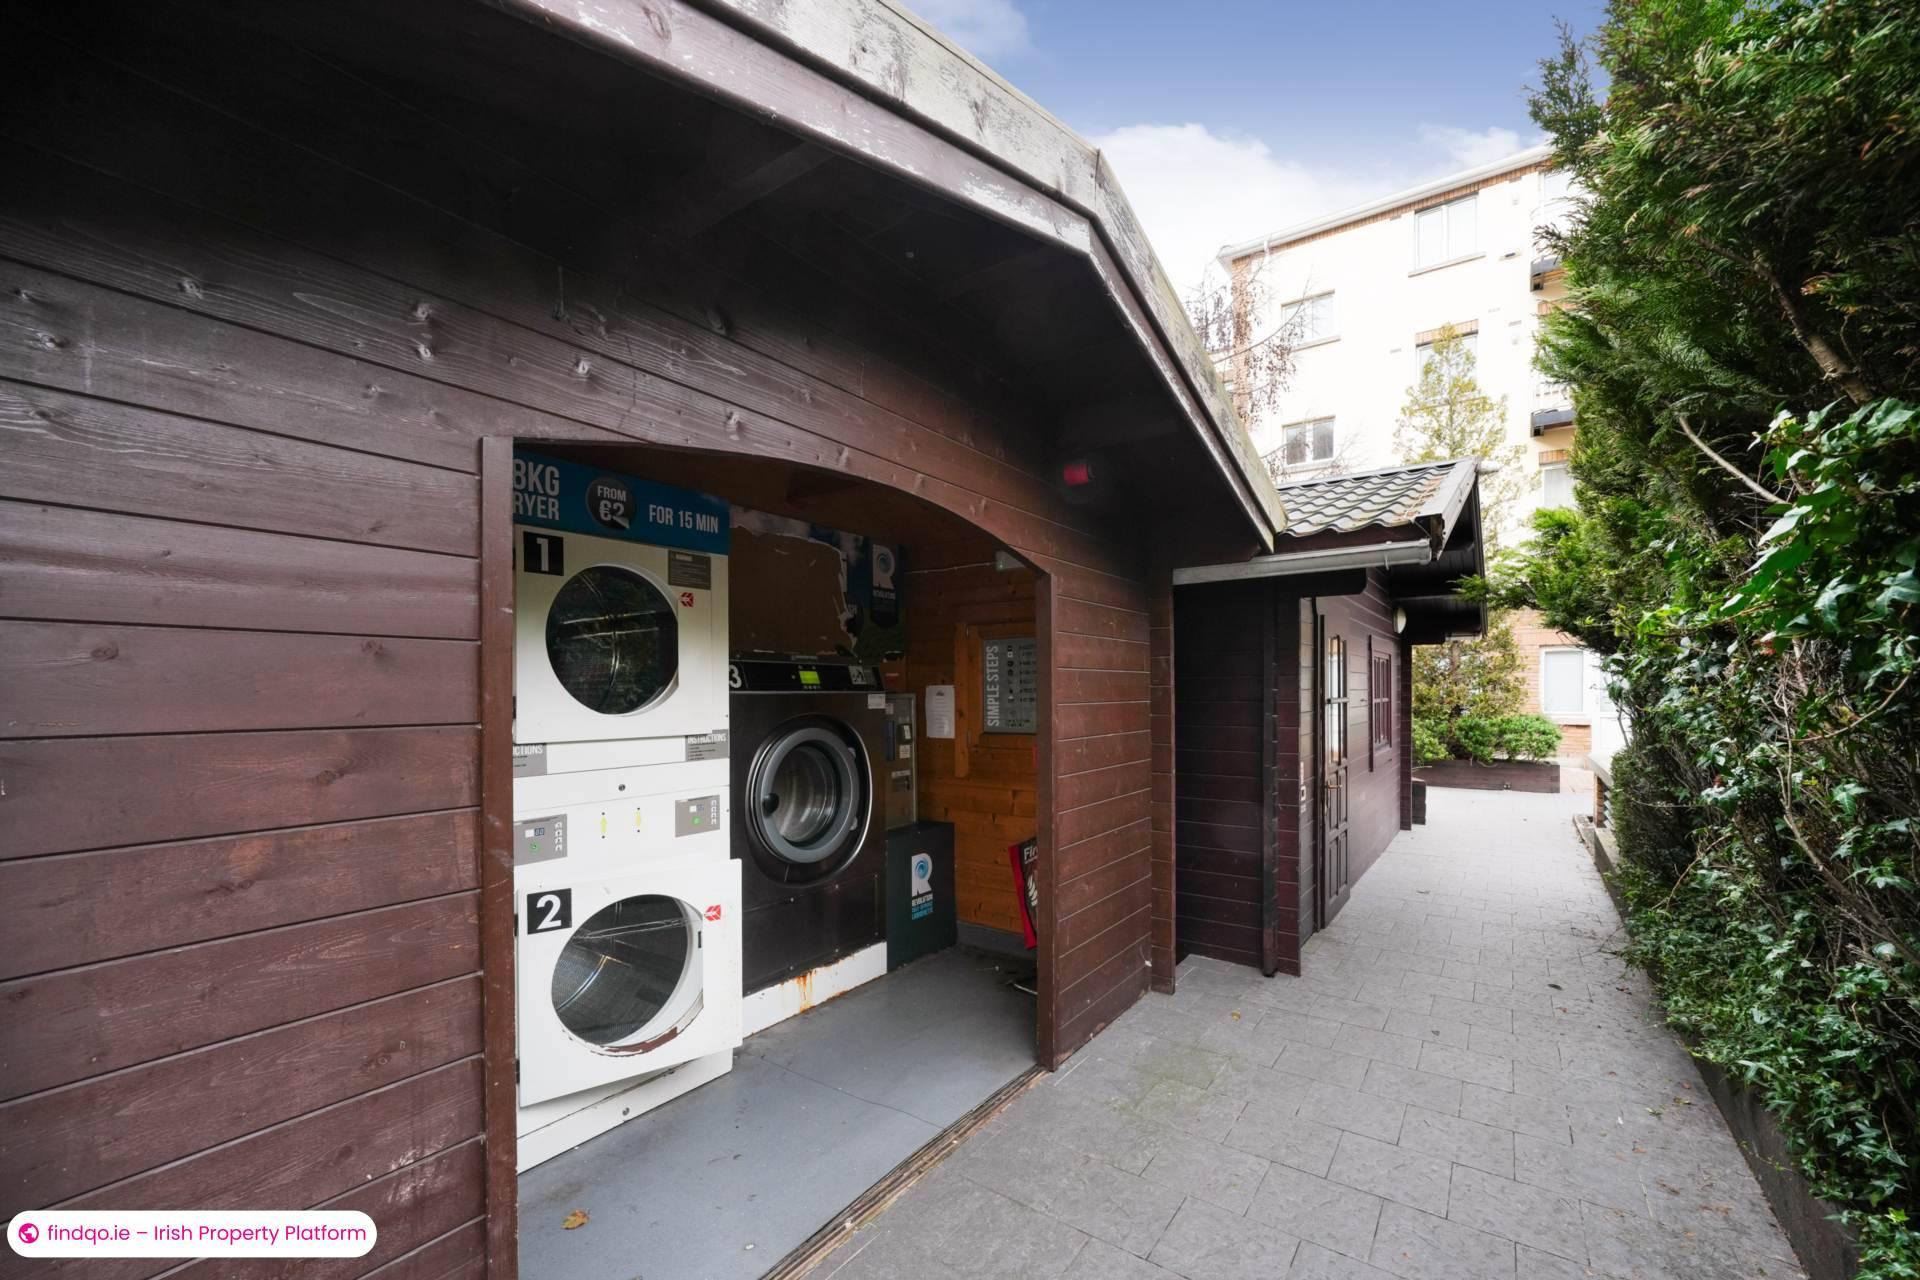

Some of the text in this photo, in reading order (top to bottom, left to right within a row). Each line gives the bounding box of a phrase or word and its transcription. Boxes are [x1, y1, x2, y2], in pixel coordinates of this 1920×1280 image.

[597, 485, 627, 502] FROM
[648, 504, 719, 534] FOR 15 MIN
[536, 537, 549, 572] 1
[729, 664, 743, 689] 3
[985, 645, 1000, 727] SIMPLE STEPS
[536, 894, 562, 930] 2
